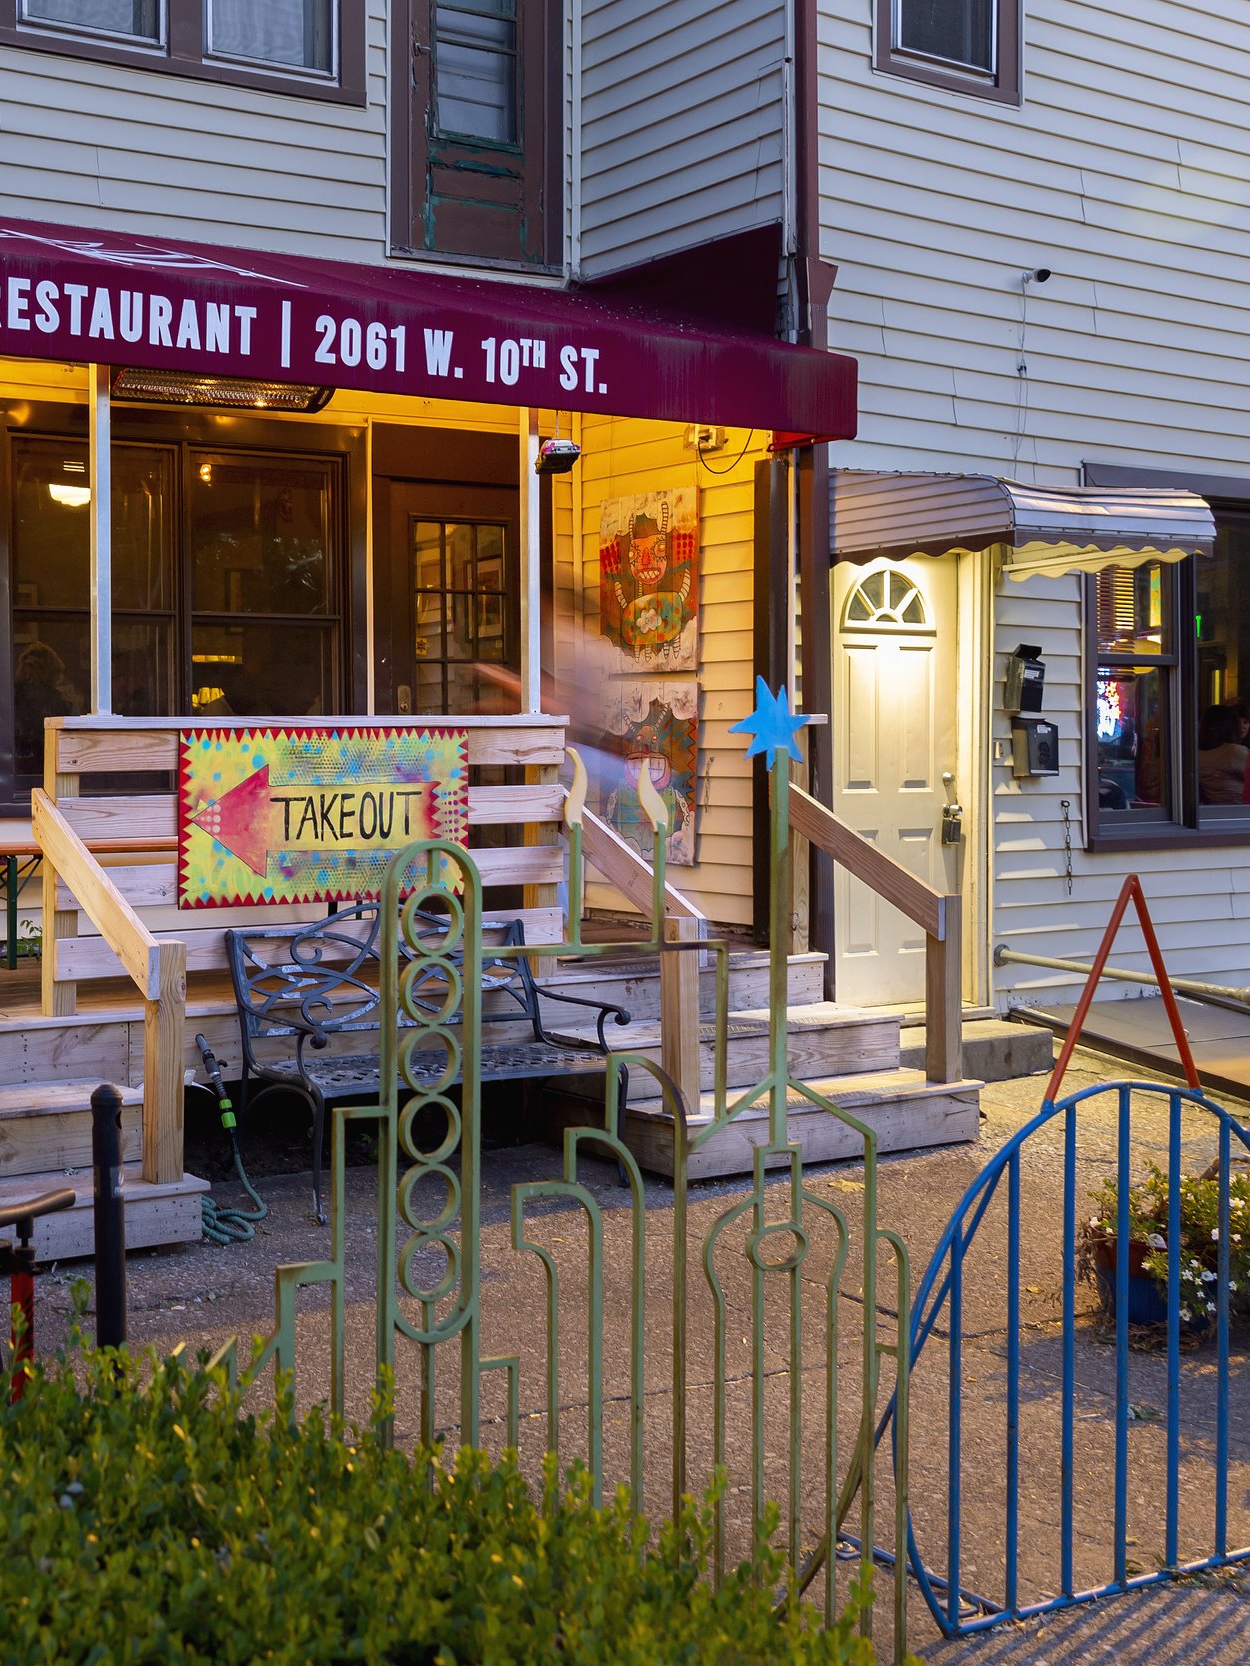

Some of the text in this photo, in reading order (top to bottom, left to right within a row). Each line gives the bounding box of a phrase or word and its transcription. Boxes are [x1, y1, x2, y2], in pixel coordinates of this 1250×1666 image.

[314, 315, 406, 372] 2061
[423, 328, 463, 378] W.
[481, 337, 545, 386] 10TH
[559, 345, 608, 394] ST.
[270, 791, 422, 842] TAKEOUT
